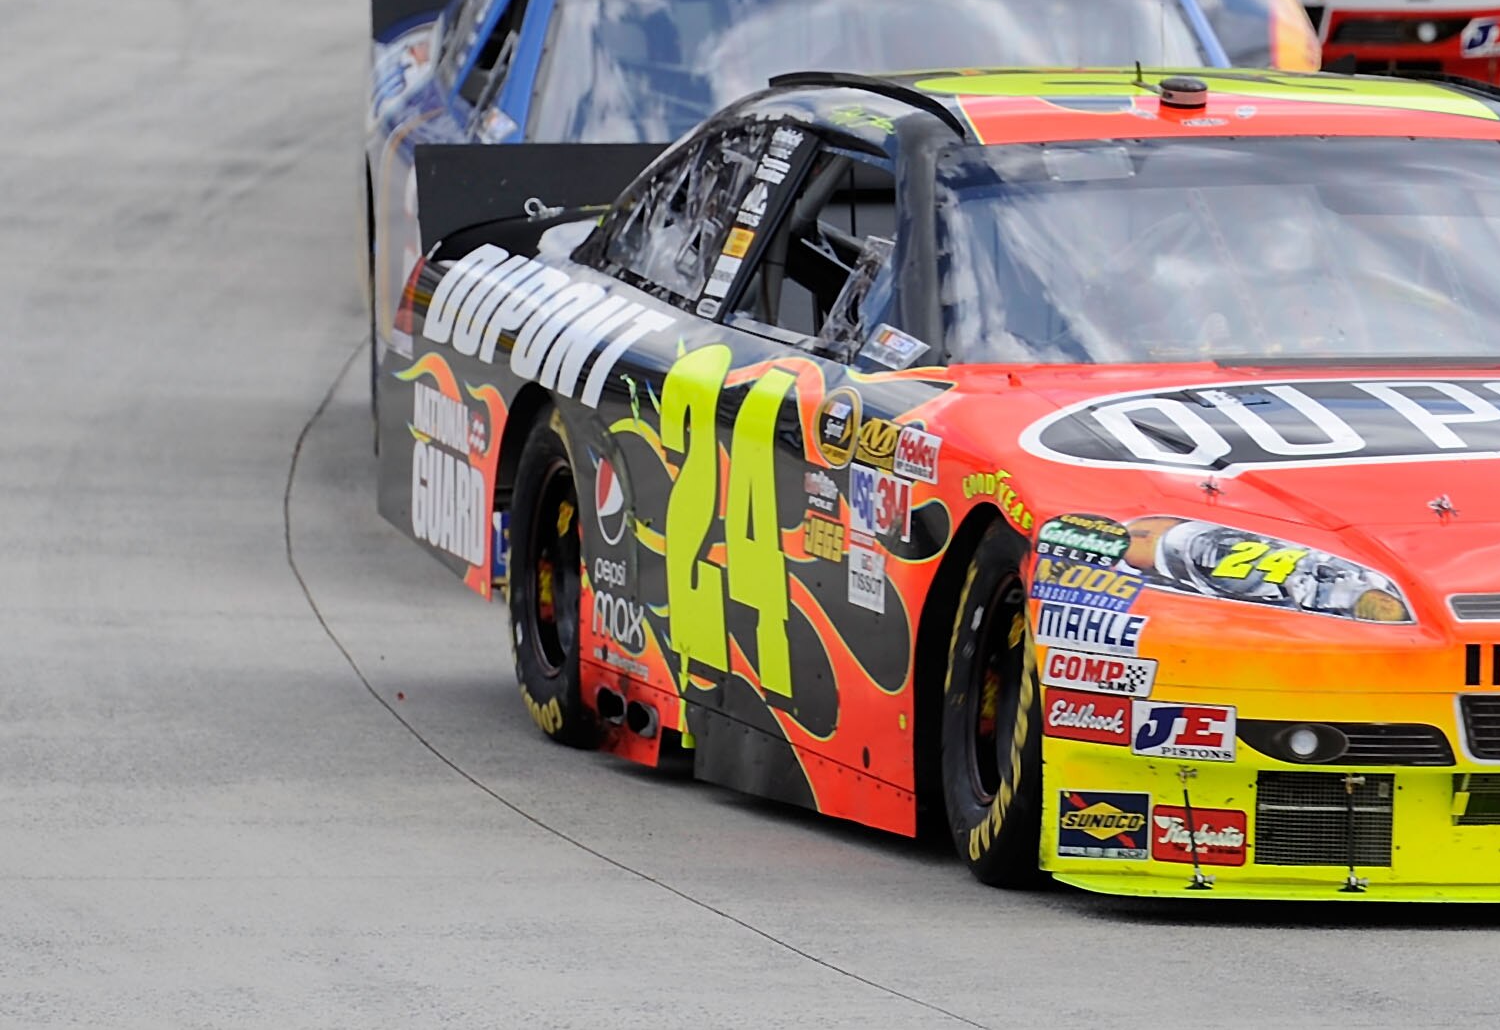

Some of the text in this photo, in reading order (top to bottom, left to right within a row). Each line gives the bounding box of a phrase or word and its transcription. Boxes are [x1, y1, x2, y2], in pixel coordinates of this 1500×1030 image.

[411, 439, 486, 567] GUARD
[808, 494, 834, 512] POLE
[875, 476, 909, 537] 3M
[659, 344, 798, 699] 24
[1036, 542, 1113, 567] BELTS
[1210, 541, 1309, 584] 24
[594, 557, 627, 589] pepsi
[850, 570, 883, 595] TISSOT
[1081, 592, 1130, 611] PARTS
[592, 590, 645, 648] max
[1037, 603, 1147, 648] MAHLE
[1049, 654, 1125, 684] COMP
[1097, 679, 1138, 694] CAMS
[1049, 699, 1125, 734] Edelbrock
[1134, 706, 1228, 751] JE
[1160, 745, 1233, 760] PISTONS
[1064, 811, 1145, 831] SUNOCO
